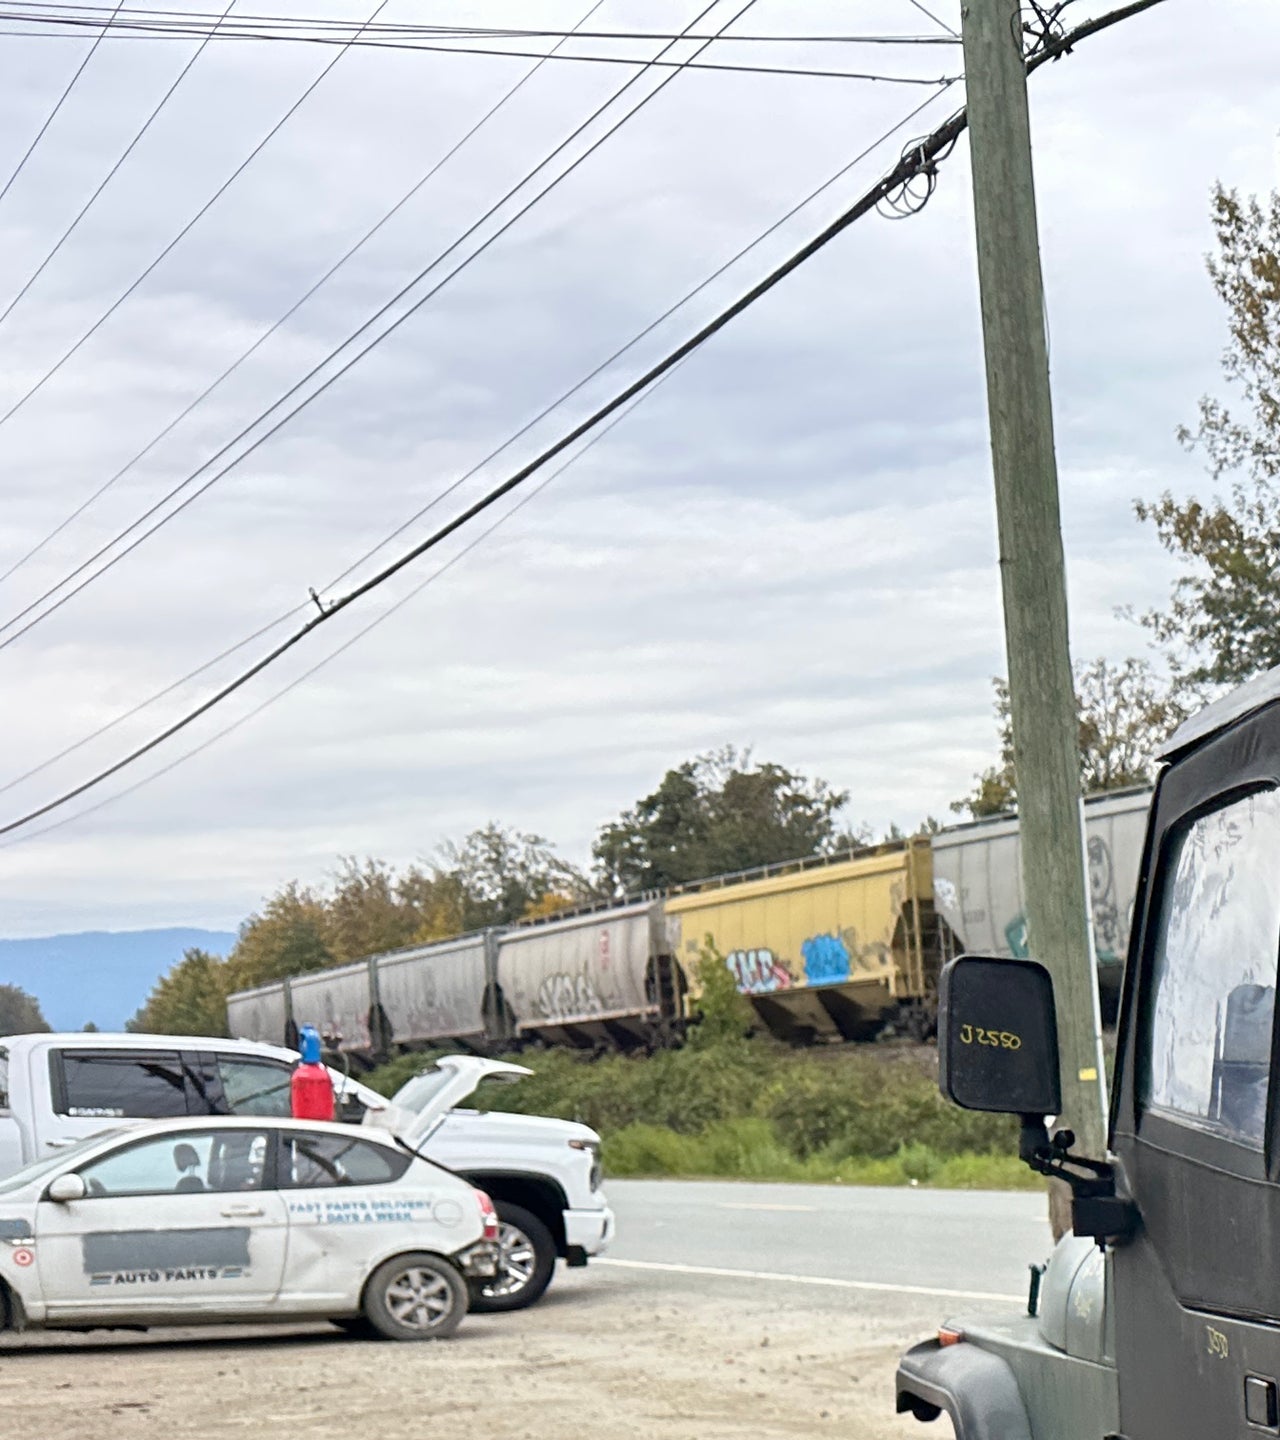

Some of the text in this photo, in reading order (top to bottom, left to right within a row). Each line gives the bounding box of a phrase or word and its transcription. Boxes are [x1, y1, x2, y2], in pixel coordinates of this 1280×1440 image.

[959, 1023, 1022, 1050] J2550
[115, 1268, 217, 1284] AUTO PARTS
